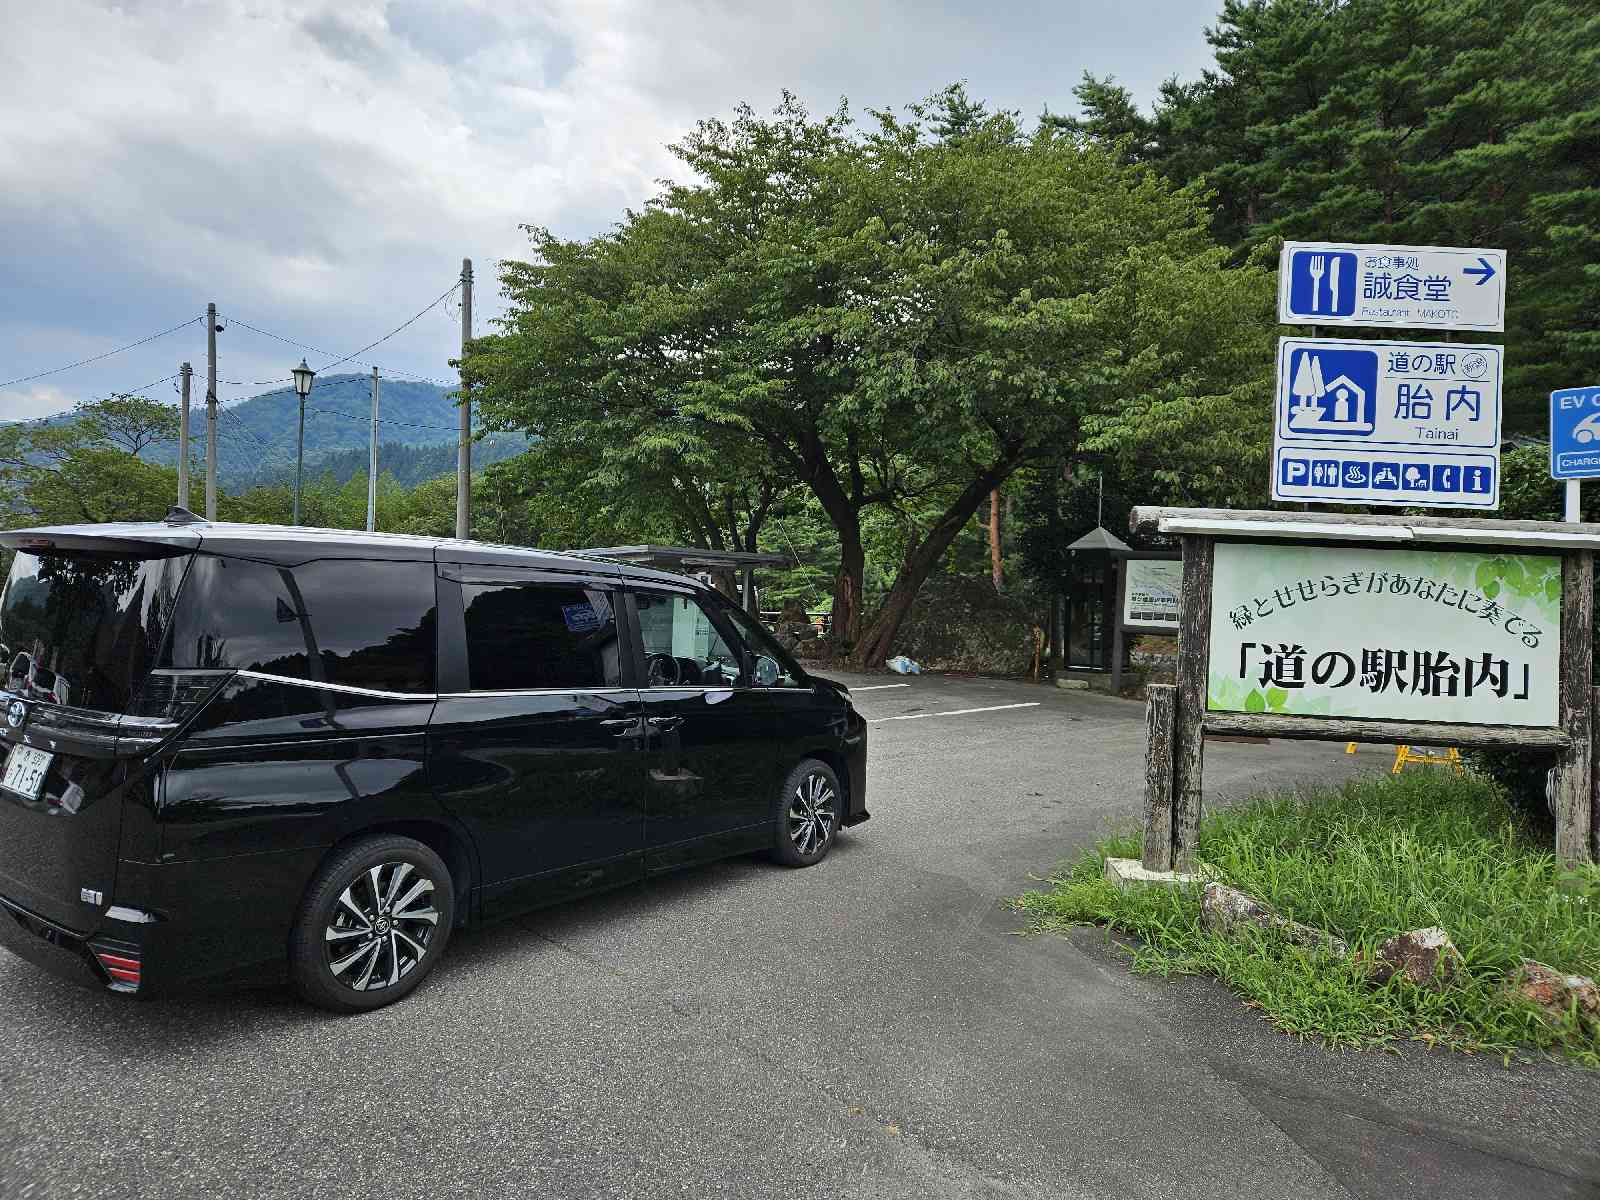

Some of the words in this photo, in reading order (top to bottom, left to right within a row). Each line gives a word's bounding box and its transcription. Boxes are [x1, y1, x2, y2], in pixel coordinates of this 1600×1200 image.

[1364, 256, 1420, 271] お食事処
[1363, 272, 1452, 302] 誠食堂
[1387, 352, 1456, 374] 道の駅
[1394, 384, 1481, 421] 胎内
[1560, 395, 1586, 410] EV
[1415, 426, 1459, 440] Tainai
[1229, 572, 1543, 649] 緑とせせらぎがあなたに奏でる
[1239, 642, 1530, 700] 「道の駅胎内」
